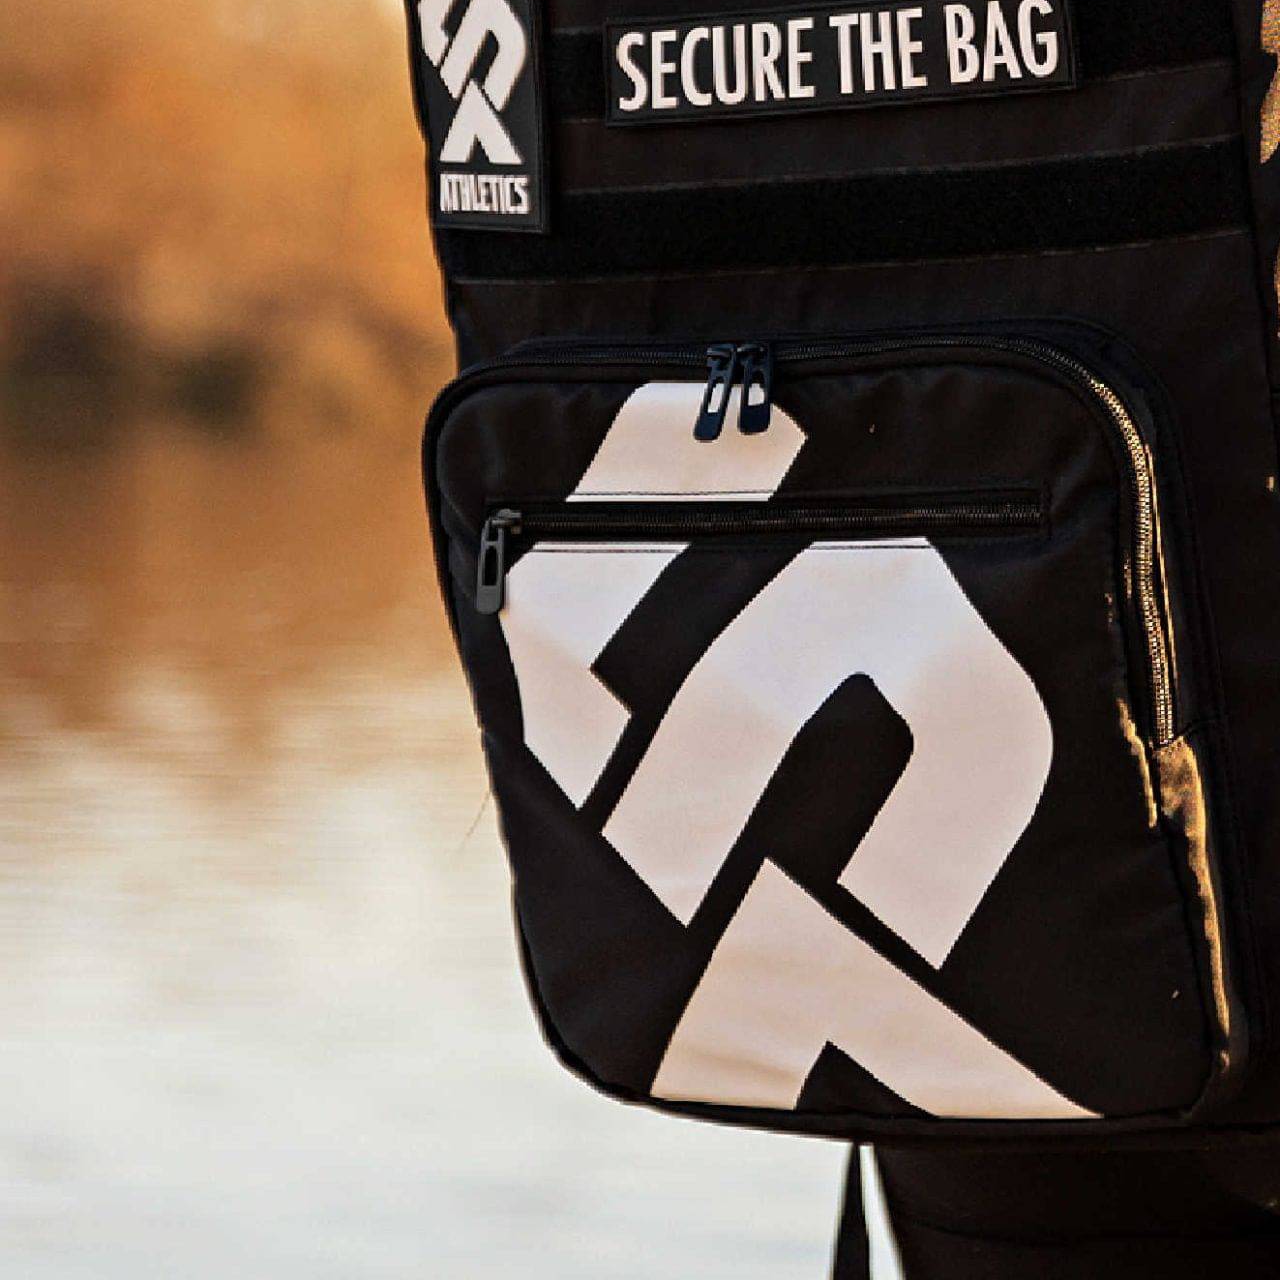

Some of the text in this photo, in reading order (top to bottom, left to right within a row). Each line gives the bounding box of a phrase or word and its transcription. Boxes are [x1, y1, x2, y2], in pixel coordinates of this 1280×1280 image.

[614, 19, 817, 113] SECURE
[829, 6, 930, 95] THE
[438, 171, 531, 216] ATHLETICS
